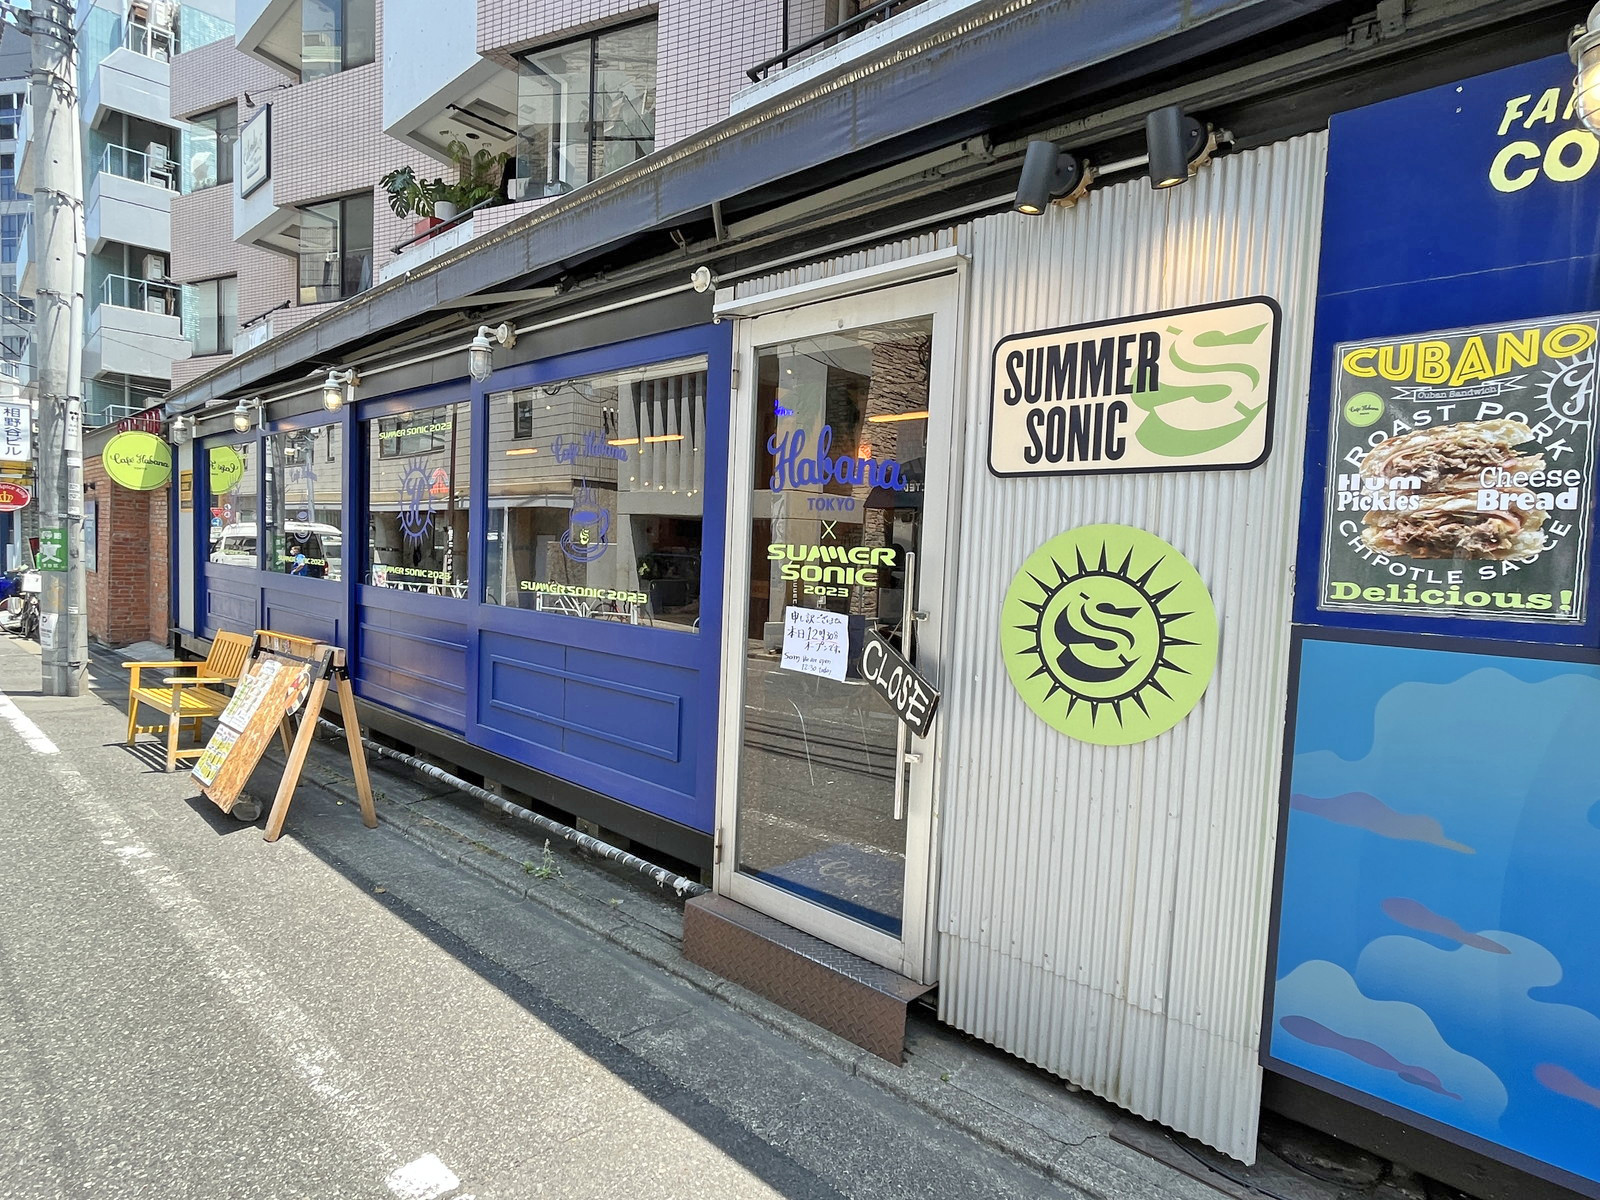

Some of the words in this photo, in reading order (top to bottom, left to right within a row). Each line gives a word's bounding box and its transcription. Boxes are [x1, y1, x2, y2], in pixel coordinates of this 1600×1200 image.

[1343, 323, 1597, 387] CUBANO
[1004, 331, 1161, 406] SUMMER
[1417, 390, 1447, 399] Cuban
[1449, 386, 1497, 398] Sandwich
[4, 407, 22, 456] 相野谷ビル
[379, 429, 406, 440] SUMMER
[407, 425, 429, 436] SONIC
[430, 421, 453, 433] 2023
[1024, 400, 1127, 464] SONIC
[1344, 403, 1456, 468] ROAST
[1475, 401, 1575, 461] PORK
[136, 454, 169, 468] Habana
[766, 424, 908, 493] Habana
[1337, 473, 1422, 491] Hum
[1480, 466, 1581, 489] Cheese
[807, 497, 855, 512] TOKYO
[1337, 491, 1420, 512] Pickles
[1477, 487, 1578, 511] Bread
[767, 543, 896, 567] SUMMER
[1339, 519, 1463, 585] CHIPOTLE
[1478, 519, 1573, 580] SAUCE
[404, 567, 427, 578] SONIC
[780, 561, 878, 587] SONIC
[520, 580, 566, 594] SUMMER
[567, 585, 606, 599] SONIC
[607, 590, 648, 604] 2023
[803, 585, 849, 598] 2023
[863, 640, 929, 726] CLOSE
